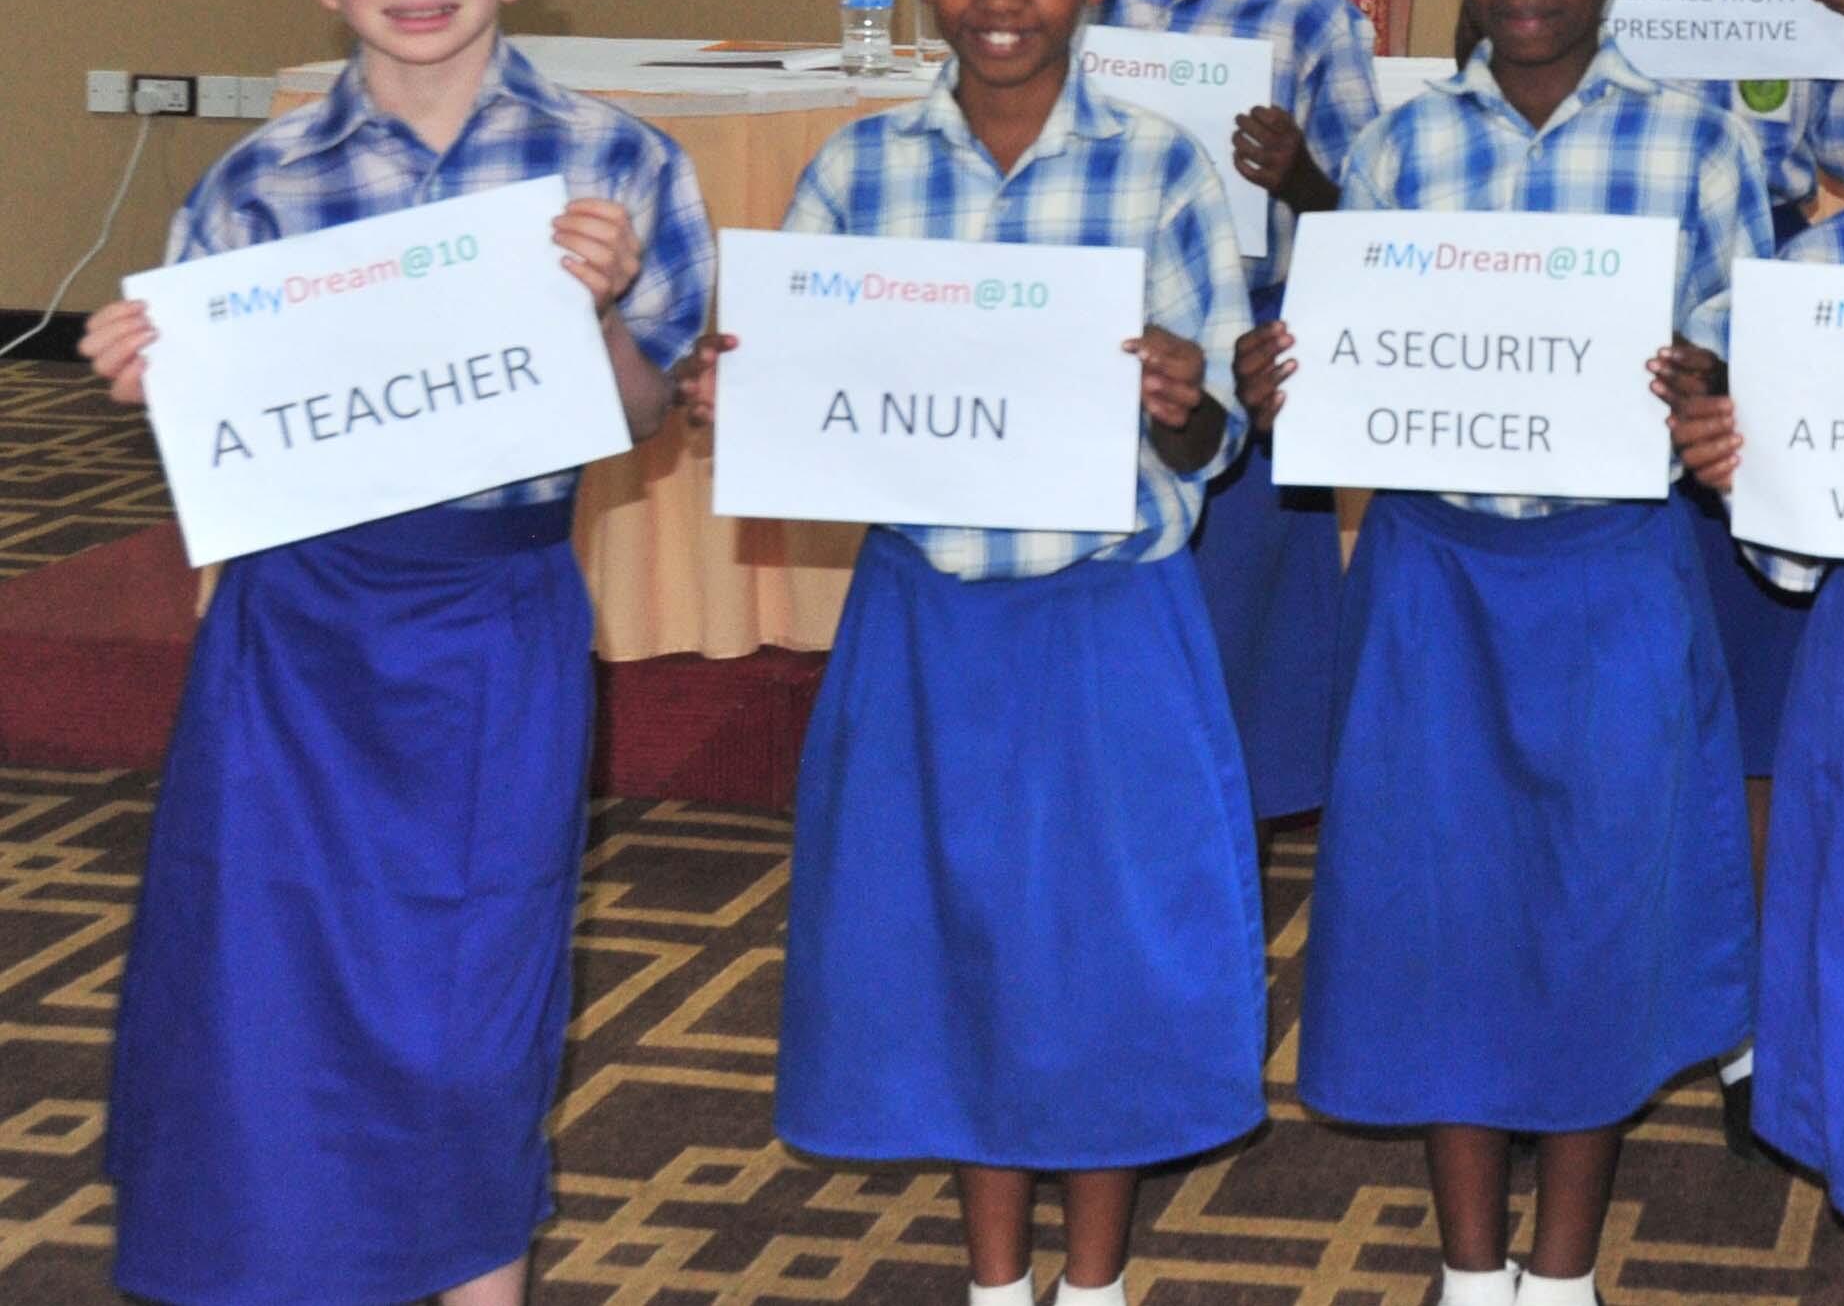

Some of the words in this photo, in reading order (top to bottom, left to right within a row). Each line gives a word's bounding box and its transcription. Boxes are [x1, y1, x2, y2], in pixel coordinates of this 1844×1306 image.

[1601, 18, 1797, 41] PRESENTATIVE
[1080, 51, 1229, 86] Dream@10
[208, 234, 479, 322] #MyDream@10
[1364, 242, 1620, 279] #MyDream@10
[789, 271, 1048, 309] #MyDream@10
[1331, 329, 1360, 365] A
[1377, 330, 1591, 374] SECURITY
[211, 420, 252, 467] A
[263, 344, 542, 451] TEACHER
[822, 390, 858, 432] A
[882, 392, 1006, 439] NUN
[1367, 408, 1550, 451] OFFICER
[1789, 418, 1814, 449] A
